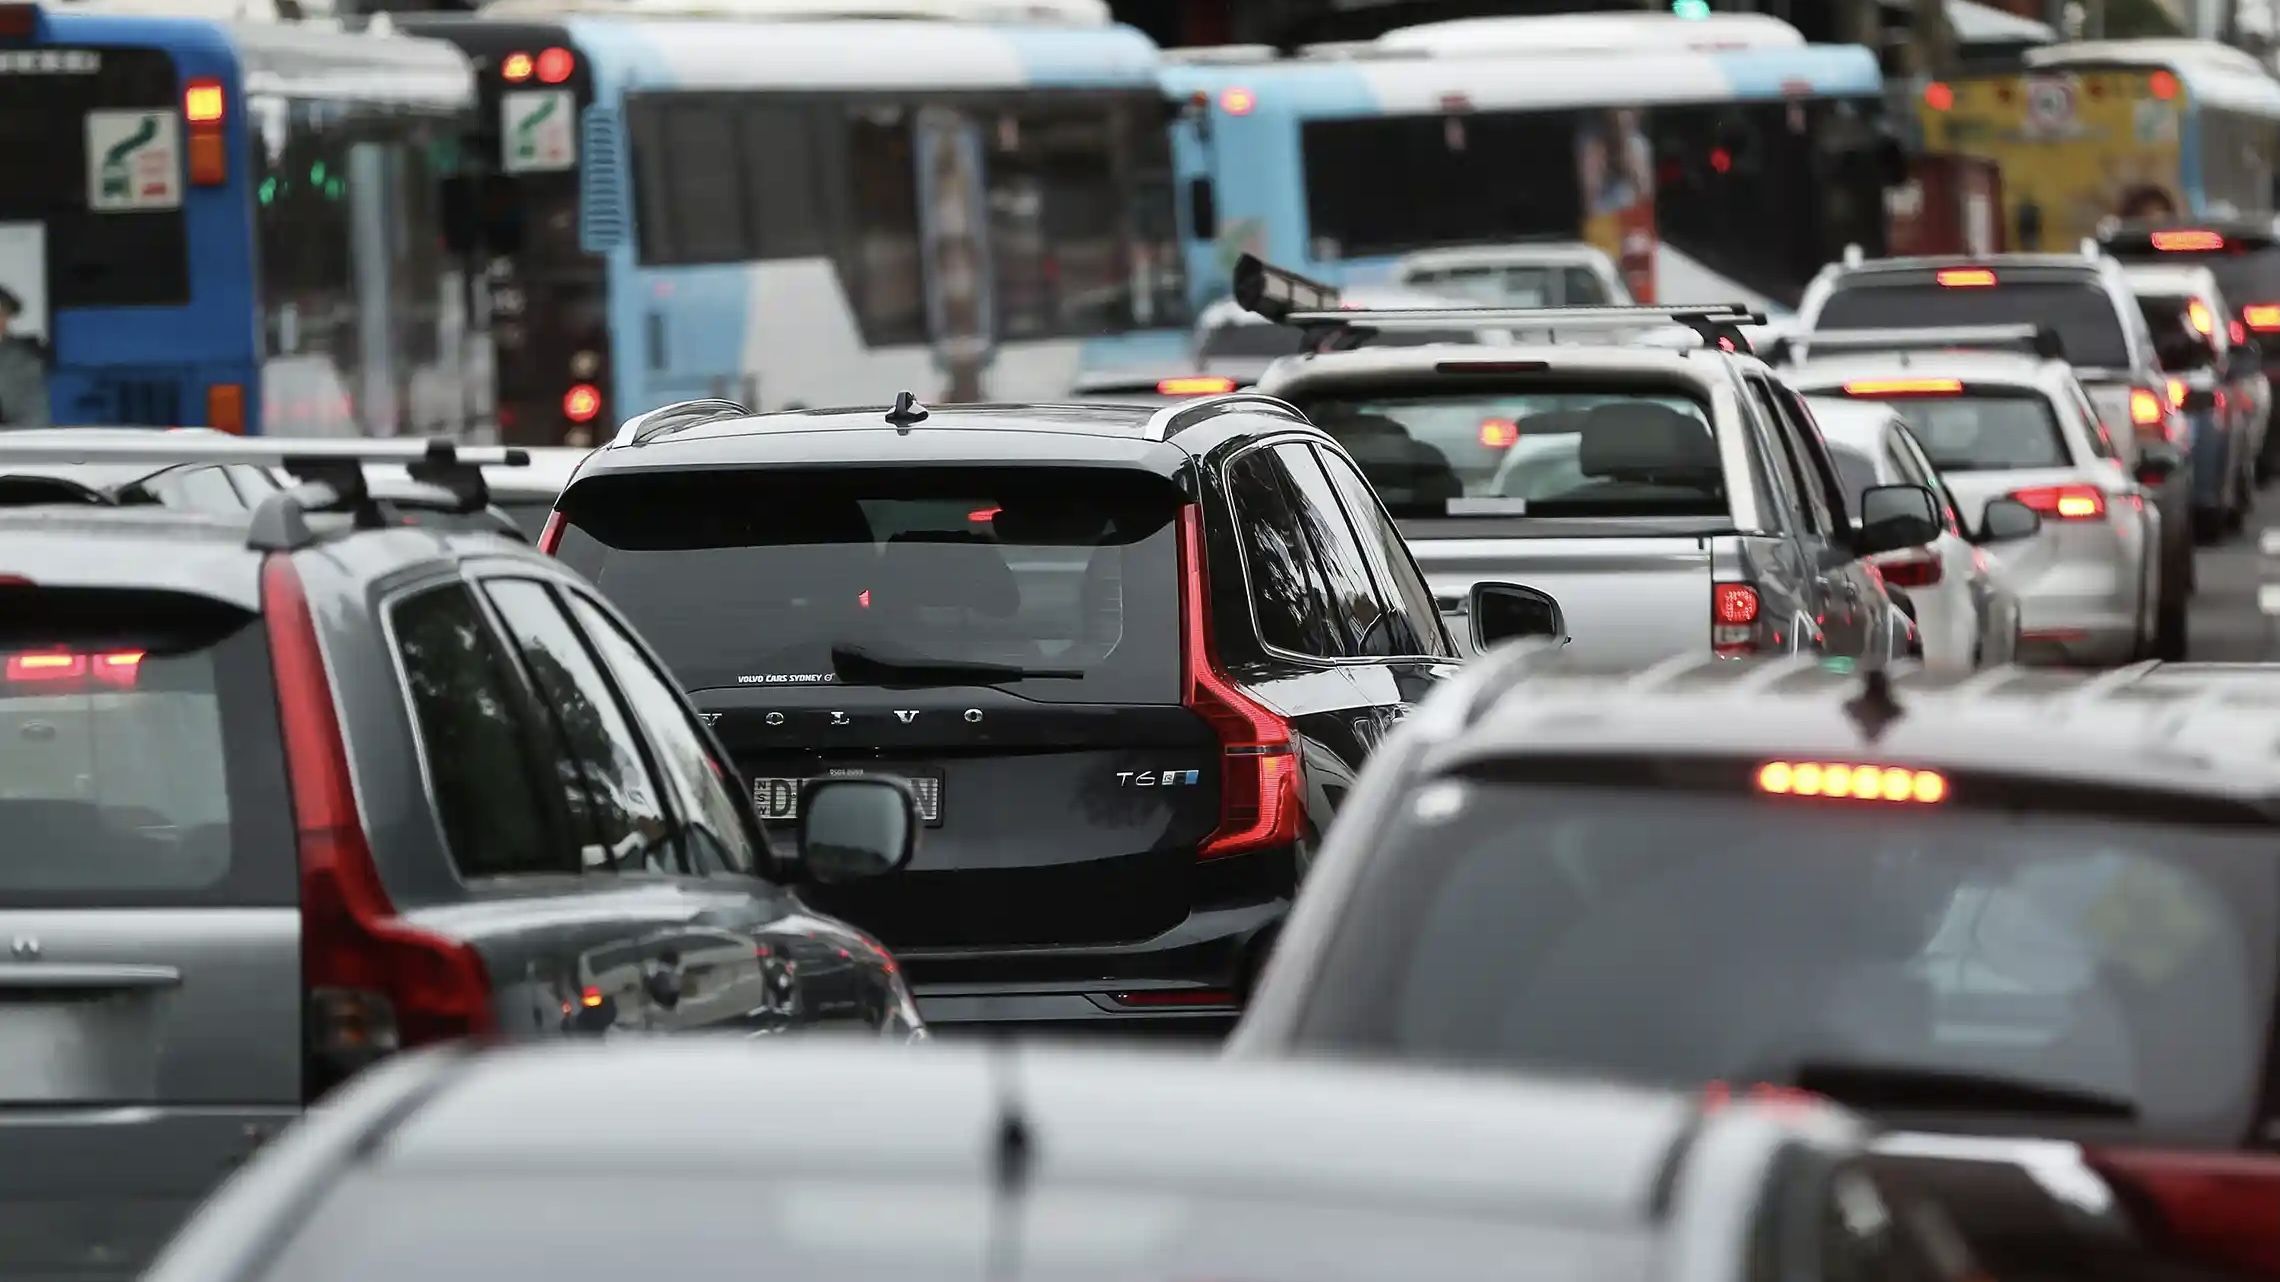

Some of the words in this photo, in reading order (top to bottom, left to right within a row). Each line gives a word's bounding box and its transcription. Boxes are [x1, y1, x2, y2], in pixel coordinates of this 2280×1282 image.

[738, 675, 763, 683] VOLVO
[765, 674, 788, 682] CARS
[789, 673, 823, 682] SYDNEY
[698, 708, 984, 727] VOLVO
[1116, 770, 1156, 787] T6
